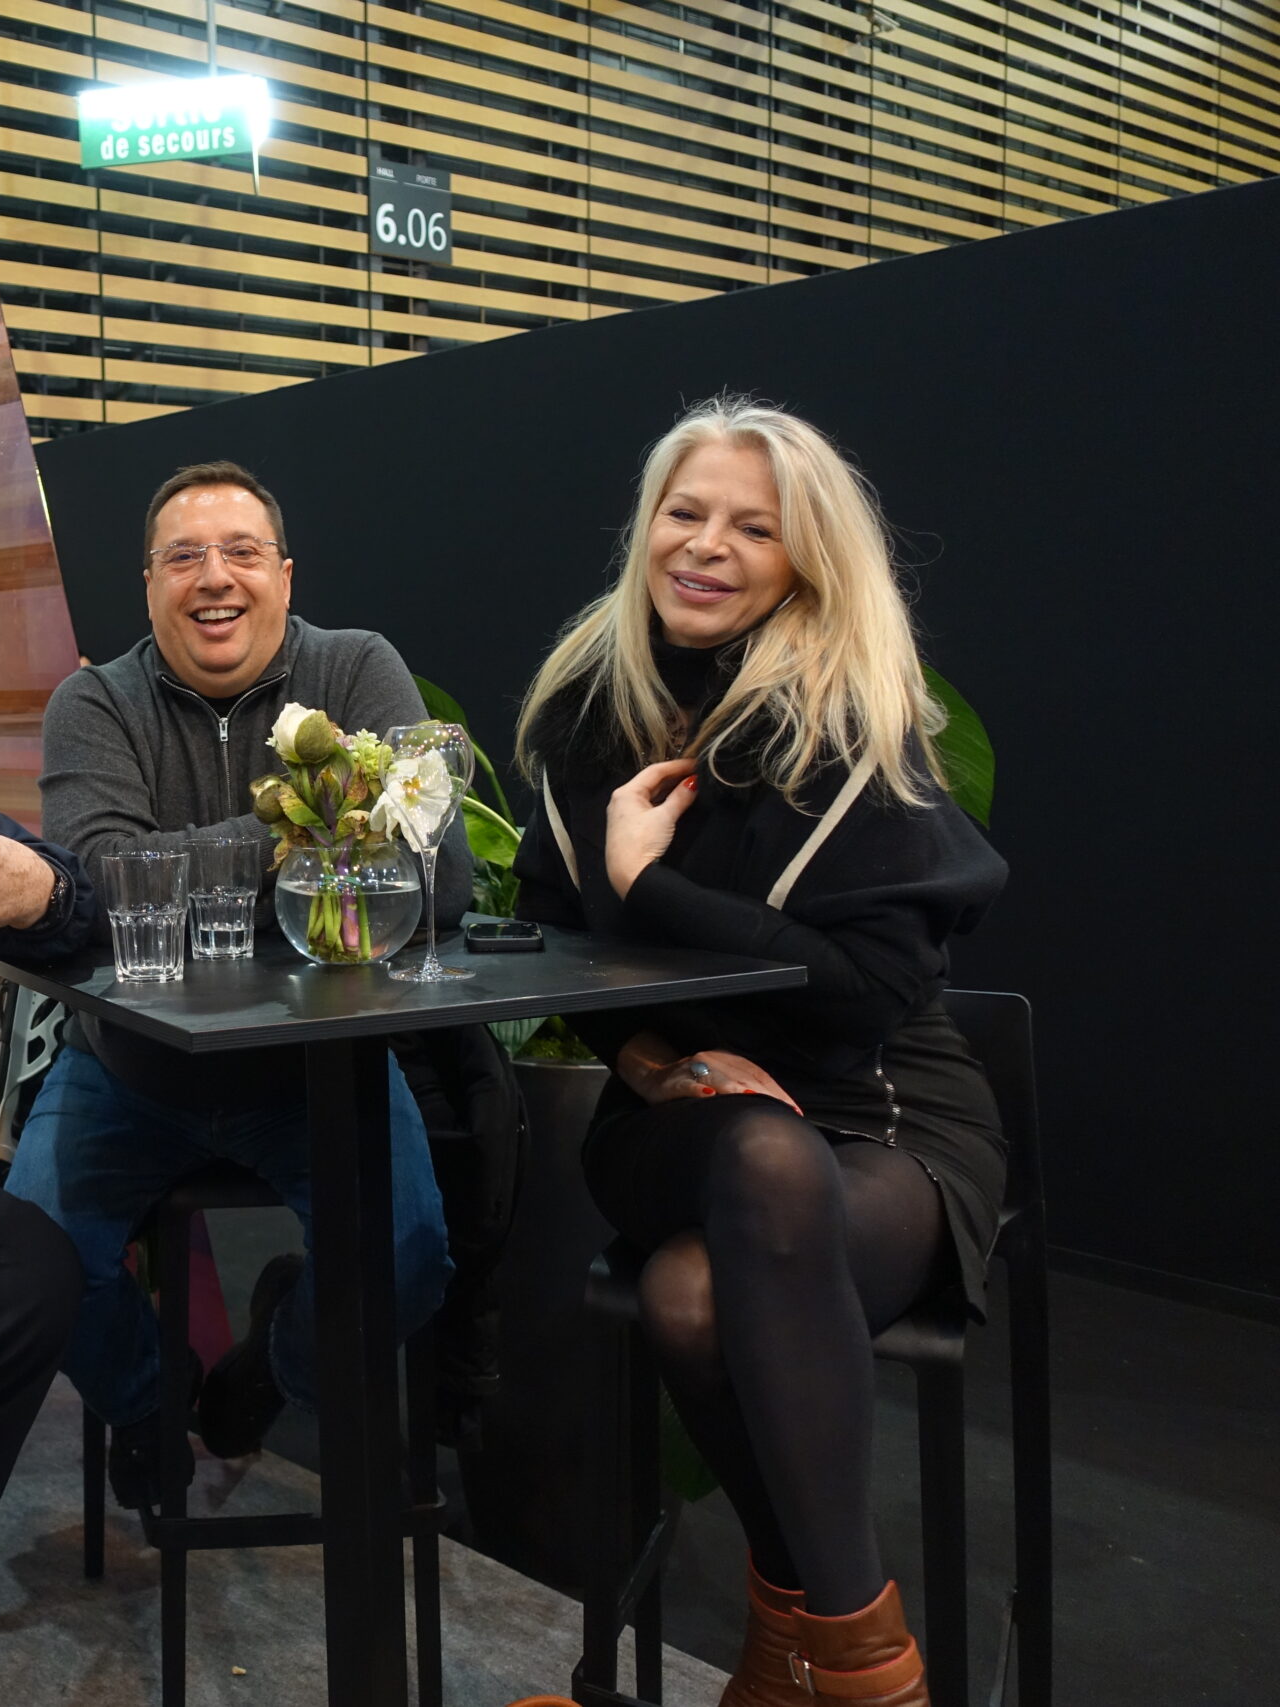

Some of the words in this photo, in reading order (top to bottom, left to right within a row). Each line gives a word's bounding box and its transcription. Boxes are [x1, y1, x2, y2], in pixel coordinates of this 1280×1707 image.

[101, 133, 129, 160] de
[138, 126, 235, 157] secours
[376, 203, 447, 251] 6.06
